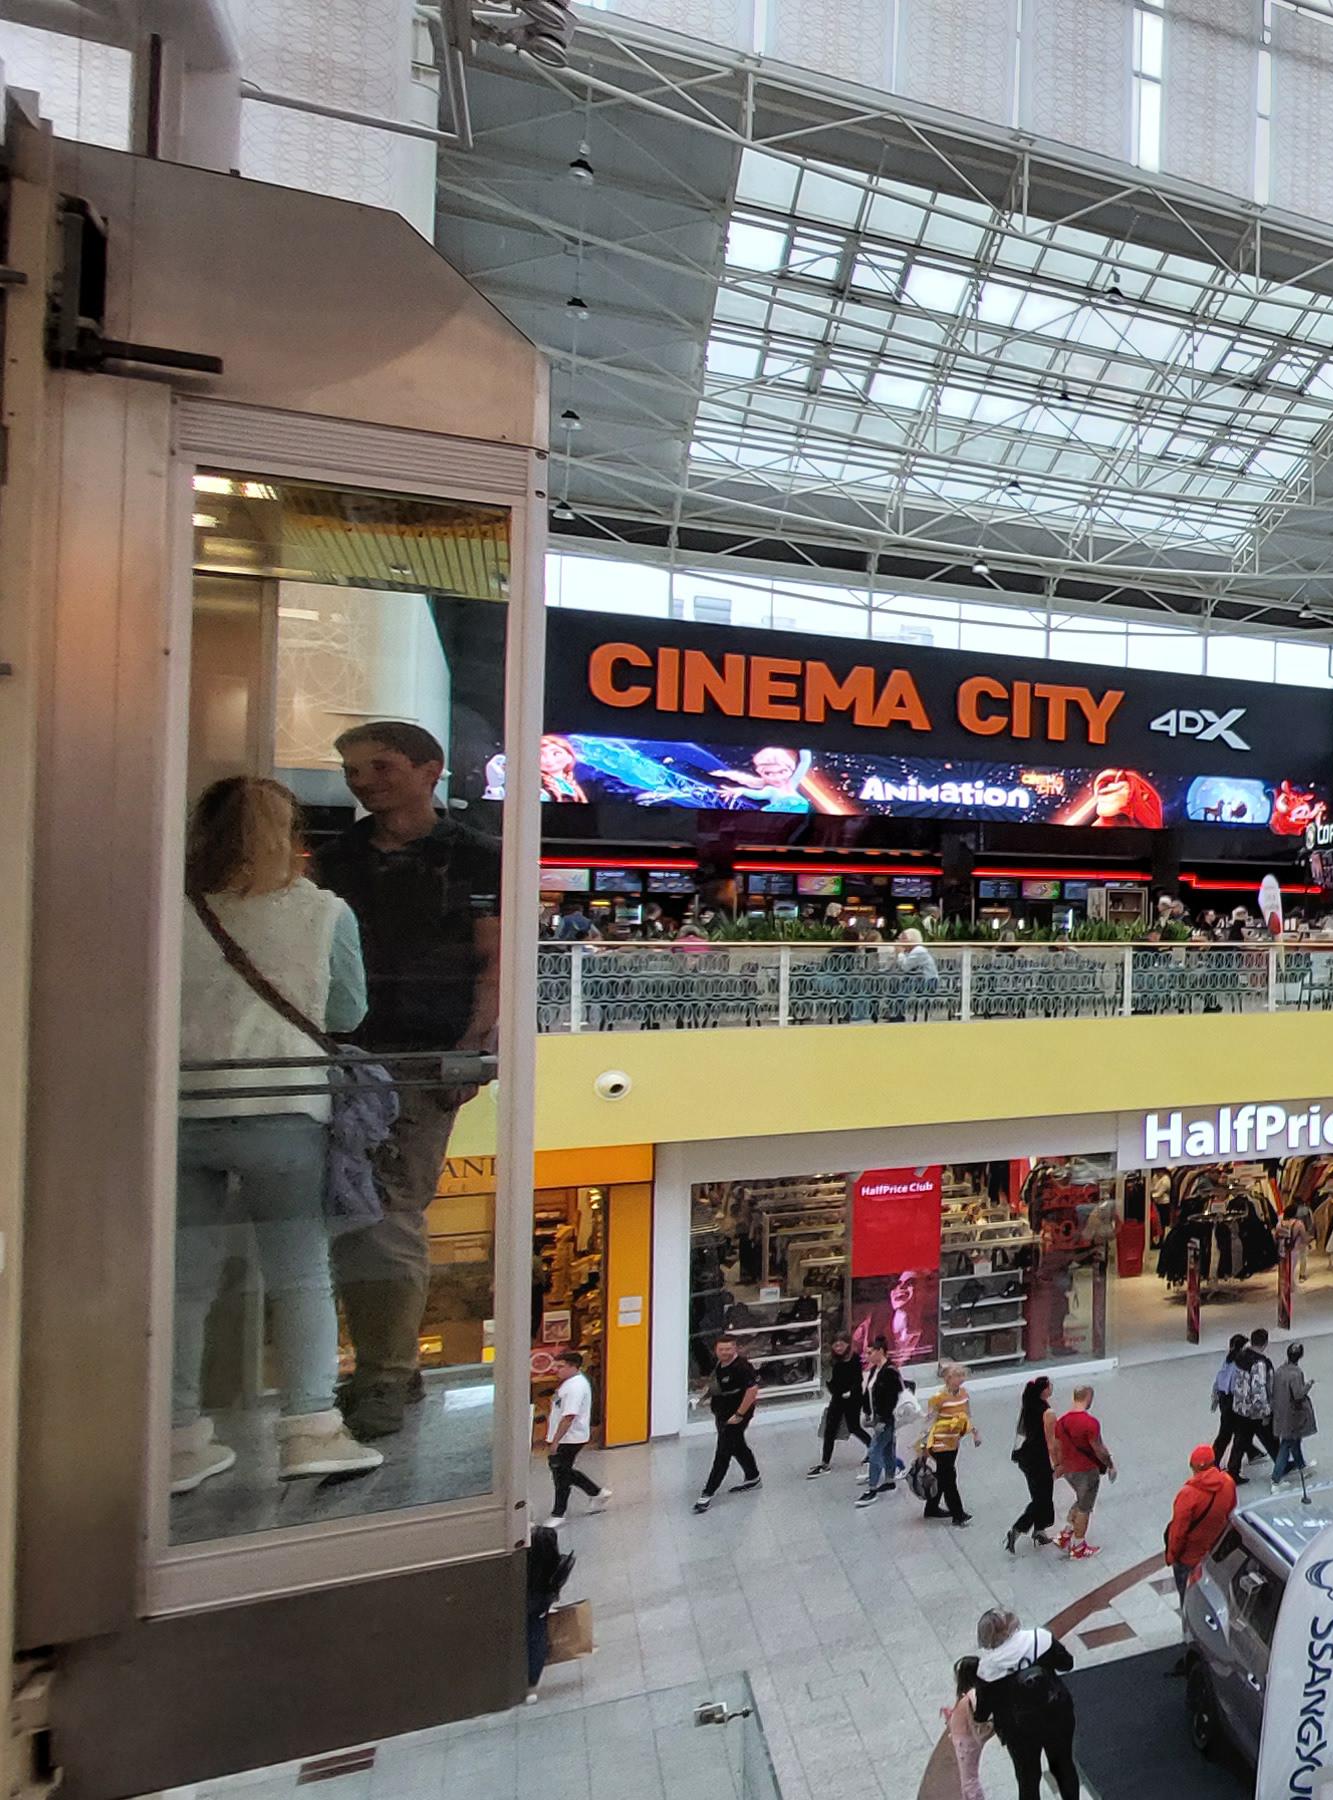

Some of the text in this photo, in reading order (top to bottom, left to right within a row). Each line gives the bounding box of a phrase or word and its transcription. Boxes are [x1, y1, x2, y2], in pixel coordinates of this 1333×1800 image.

[588, 642, 1251, 751] CINEMA CITY 4DX
[861, 1181, 934, 1197] HalfPrice Club
